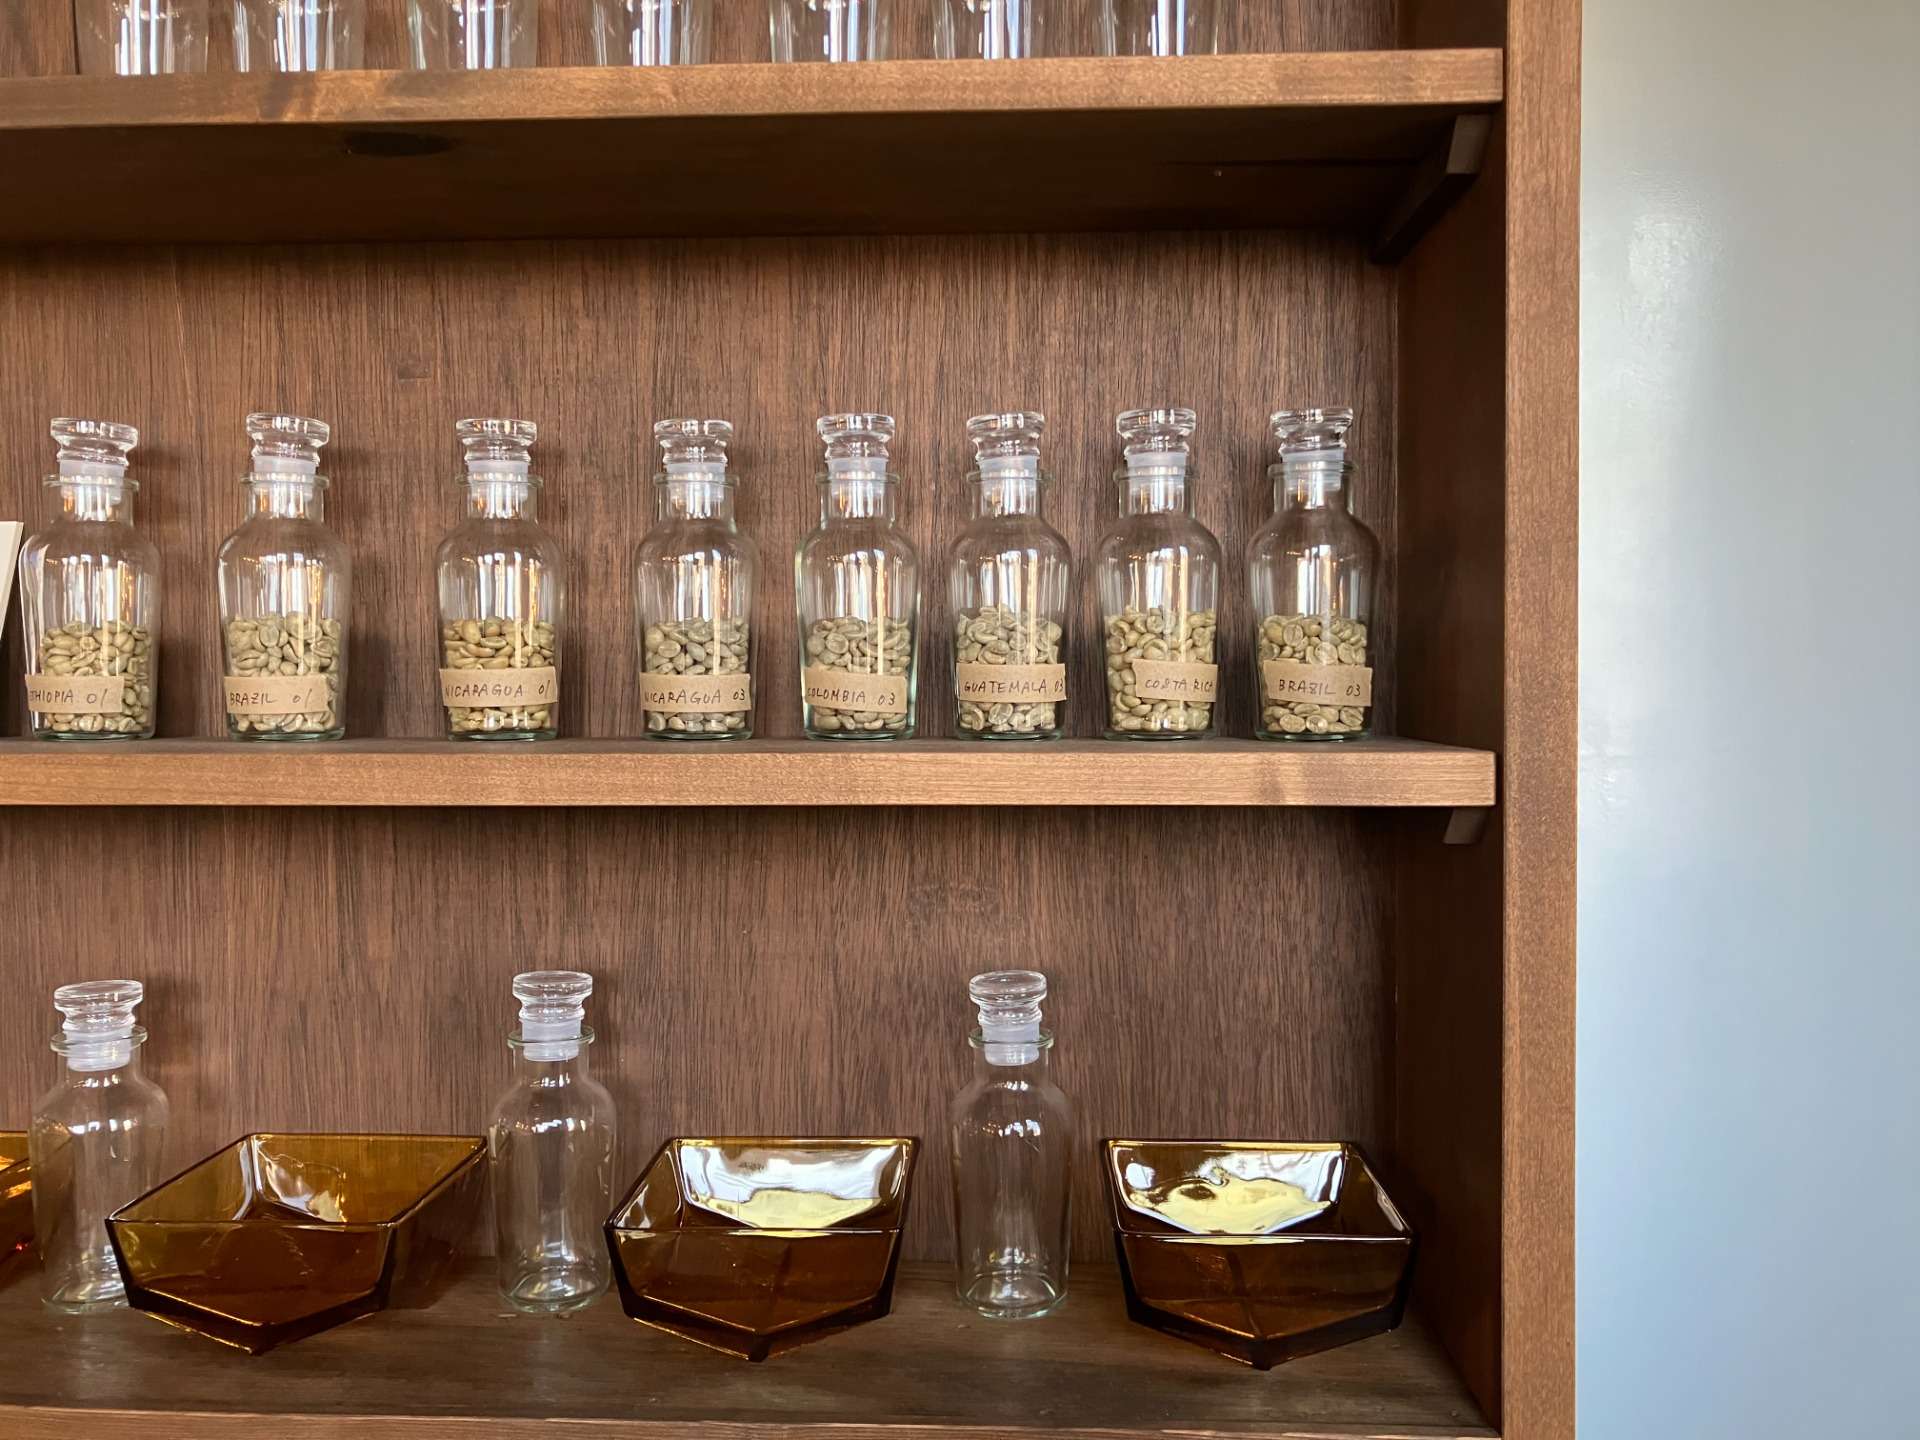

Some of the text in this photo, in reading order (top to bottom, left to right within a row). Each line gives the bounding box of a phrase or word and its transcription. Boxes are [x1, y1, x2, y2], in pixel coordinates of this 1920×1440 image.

[964, 678, 1047, 696] GUATEMALA
[1145, 678, 1187, 692] COSTA
[1278, 678, 1361, 697] BRAZIL 03
[229, 691, 274, 706] BRAZIL
[732, 688, 746, 701] 03
[807, 687, 896, 706] COLOMBIA 03
